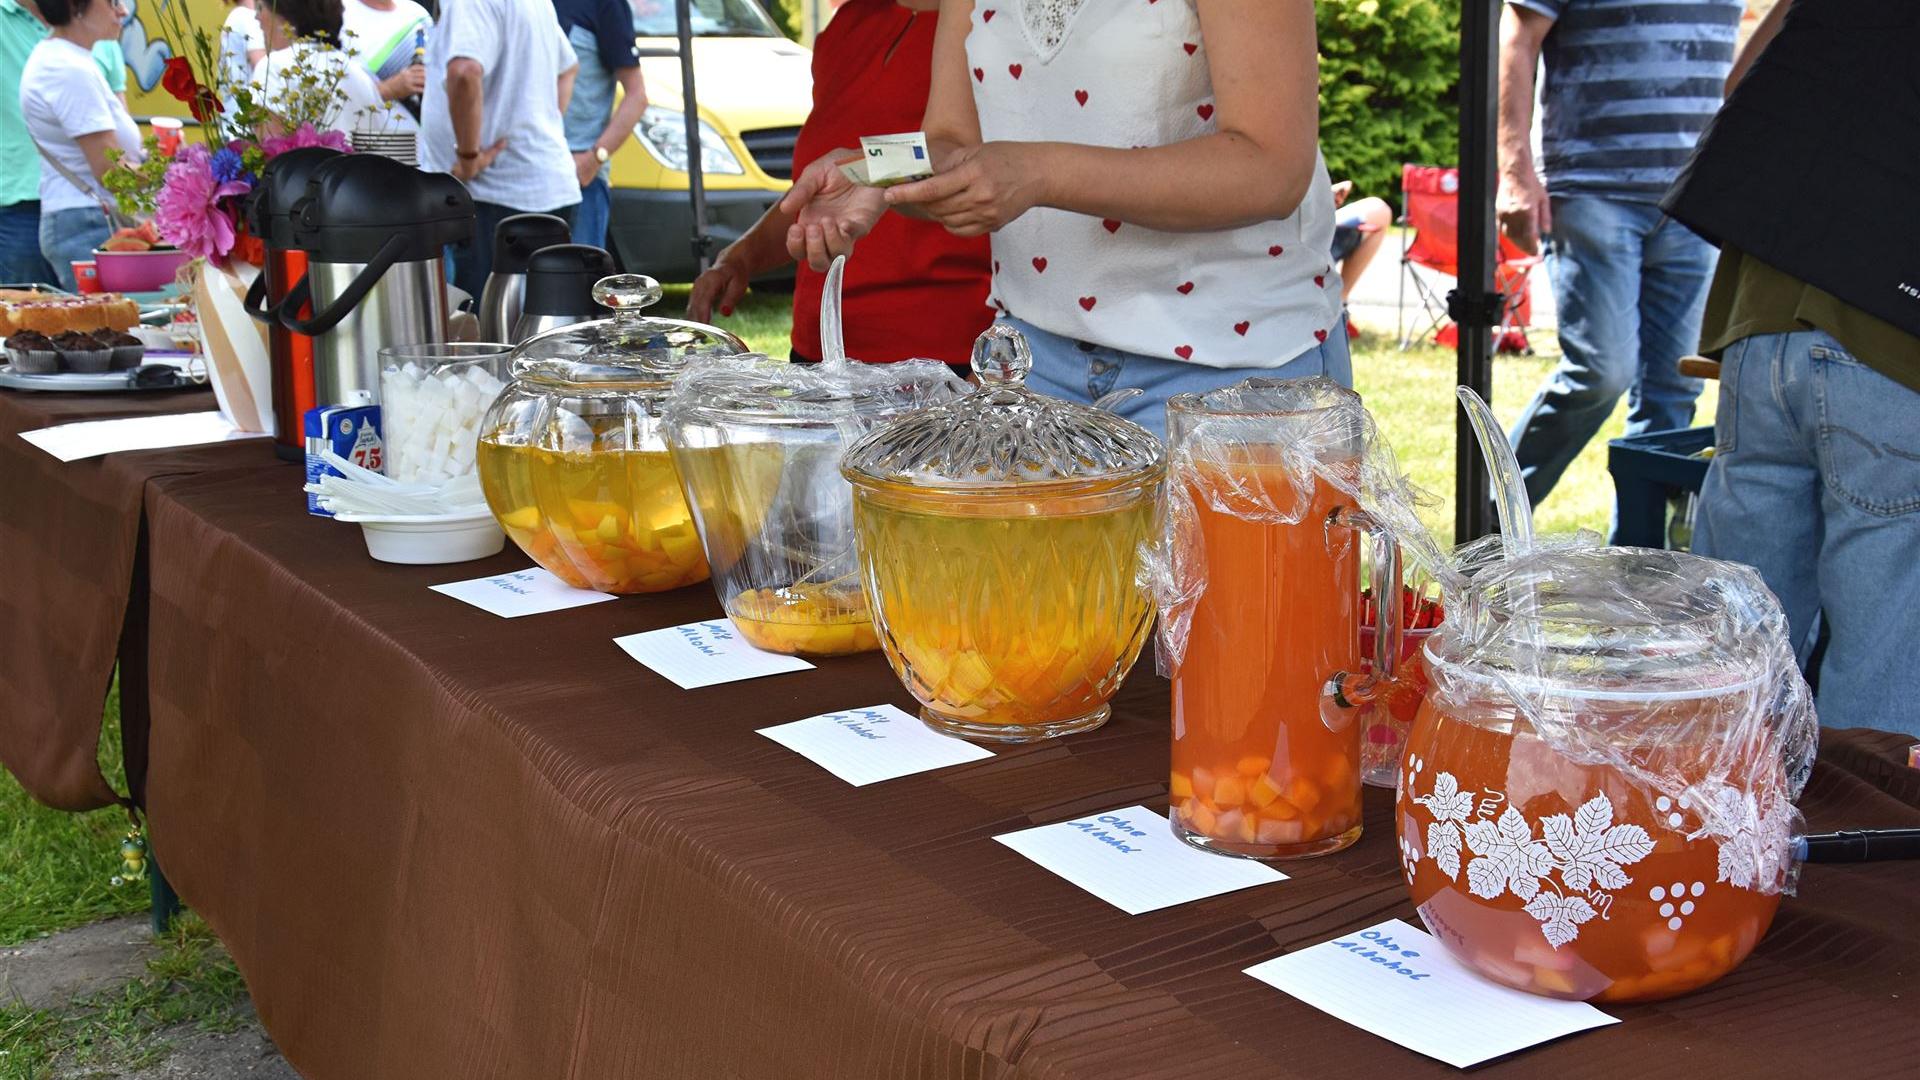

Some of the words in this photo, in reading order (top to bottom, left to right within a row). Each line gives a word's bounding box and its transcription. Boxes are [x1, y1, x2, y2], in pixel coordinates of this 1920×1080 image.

[867, 148, 883, 157] 5
[676, 627, 725, 657] Alkohol
[700, 623, 733, 640] Mit
[822, 715, 887, 740] Alkohol
[849, 710, 890, 724] Mit
[1066, 822, 1142, 854] Alkohol
[1097, 815, 1147, 837] Ohne
[1360, 931, 1420, 958] Ohne
[1331, 941, 1431, 981] Alkohol
